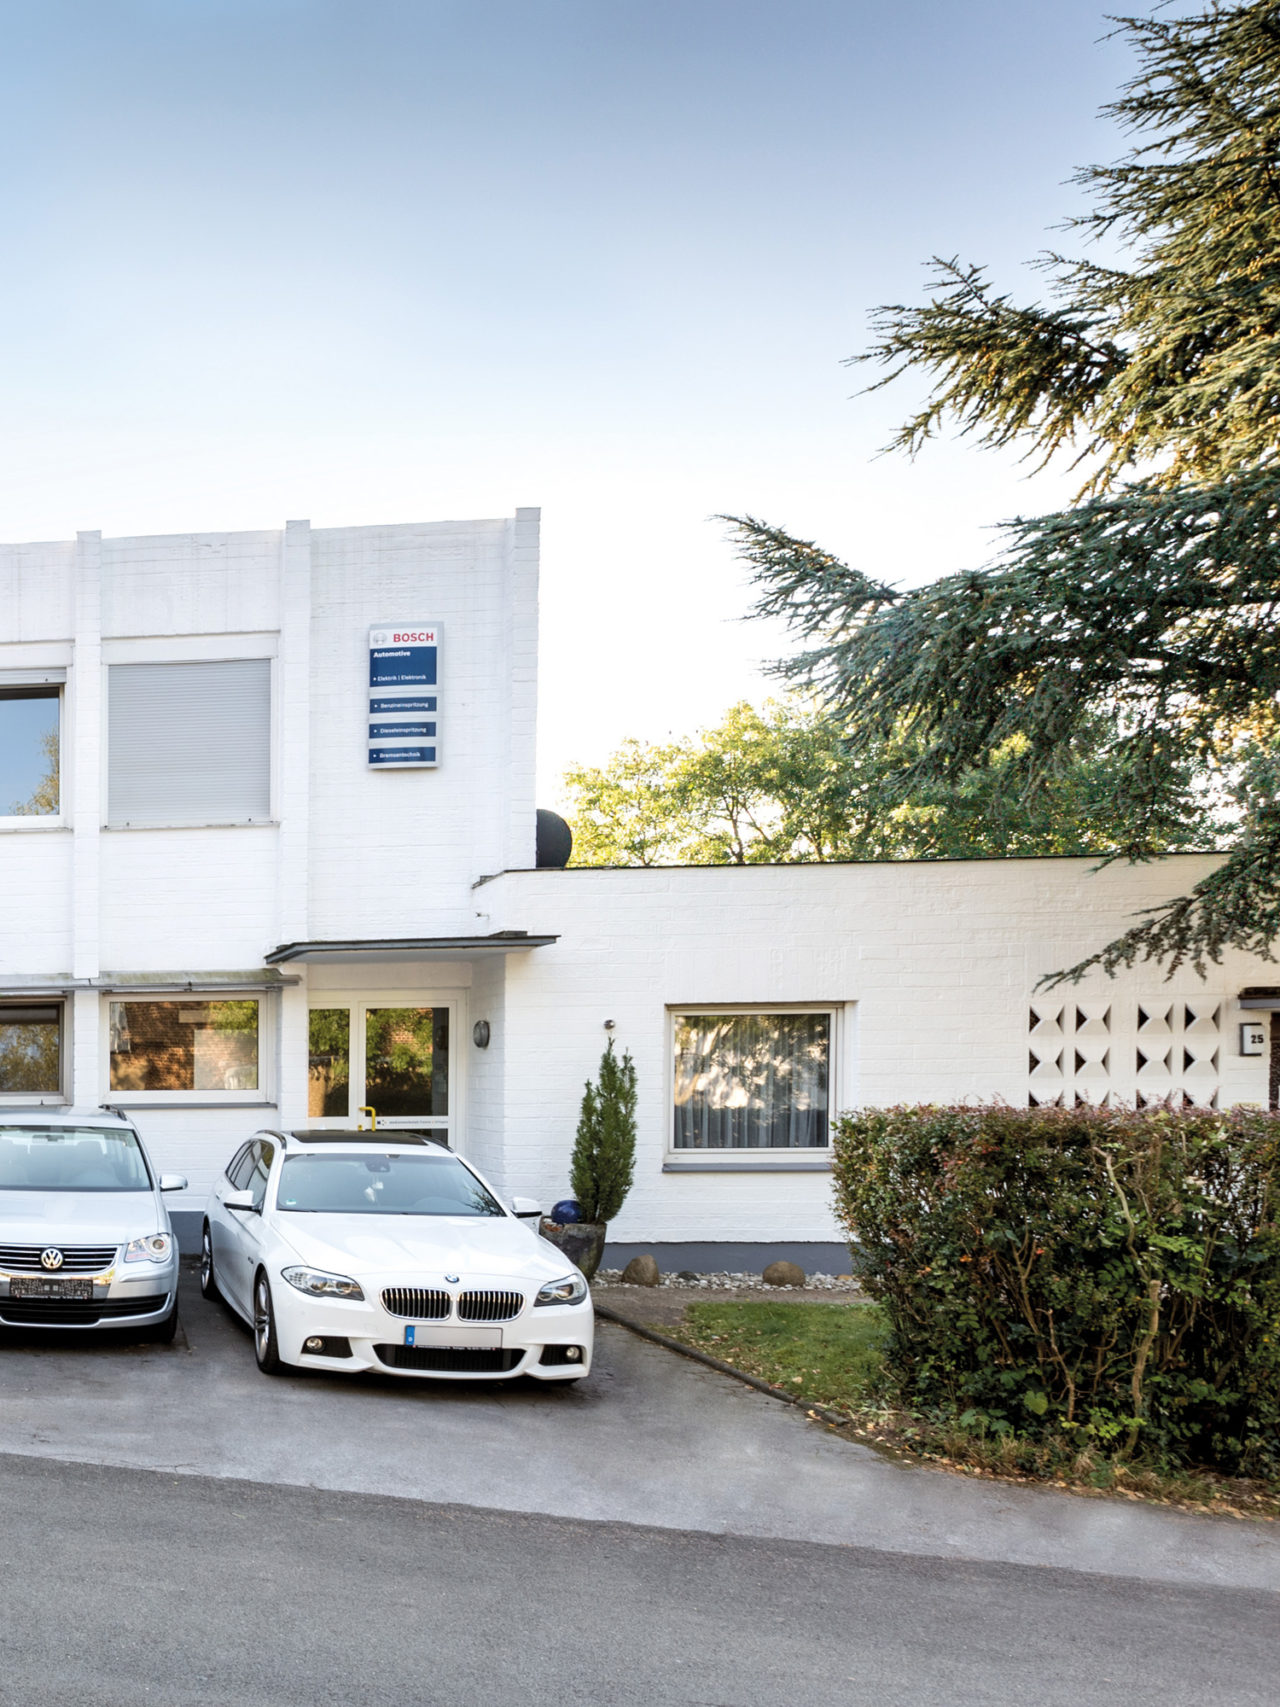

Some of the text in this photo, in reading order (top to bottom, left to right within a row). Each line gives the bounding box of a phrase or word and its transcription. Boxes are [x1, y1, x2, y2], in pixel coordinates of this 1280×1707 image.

[393, 632, 434, 643] BOSCH
[373, 650, 411, 658] Automotive
[1250, 1034, 1264, 1044] 25
